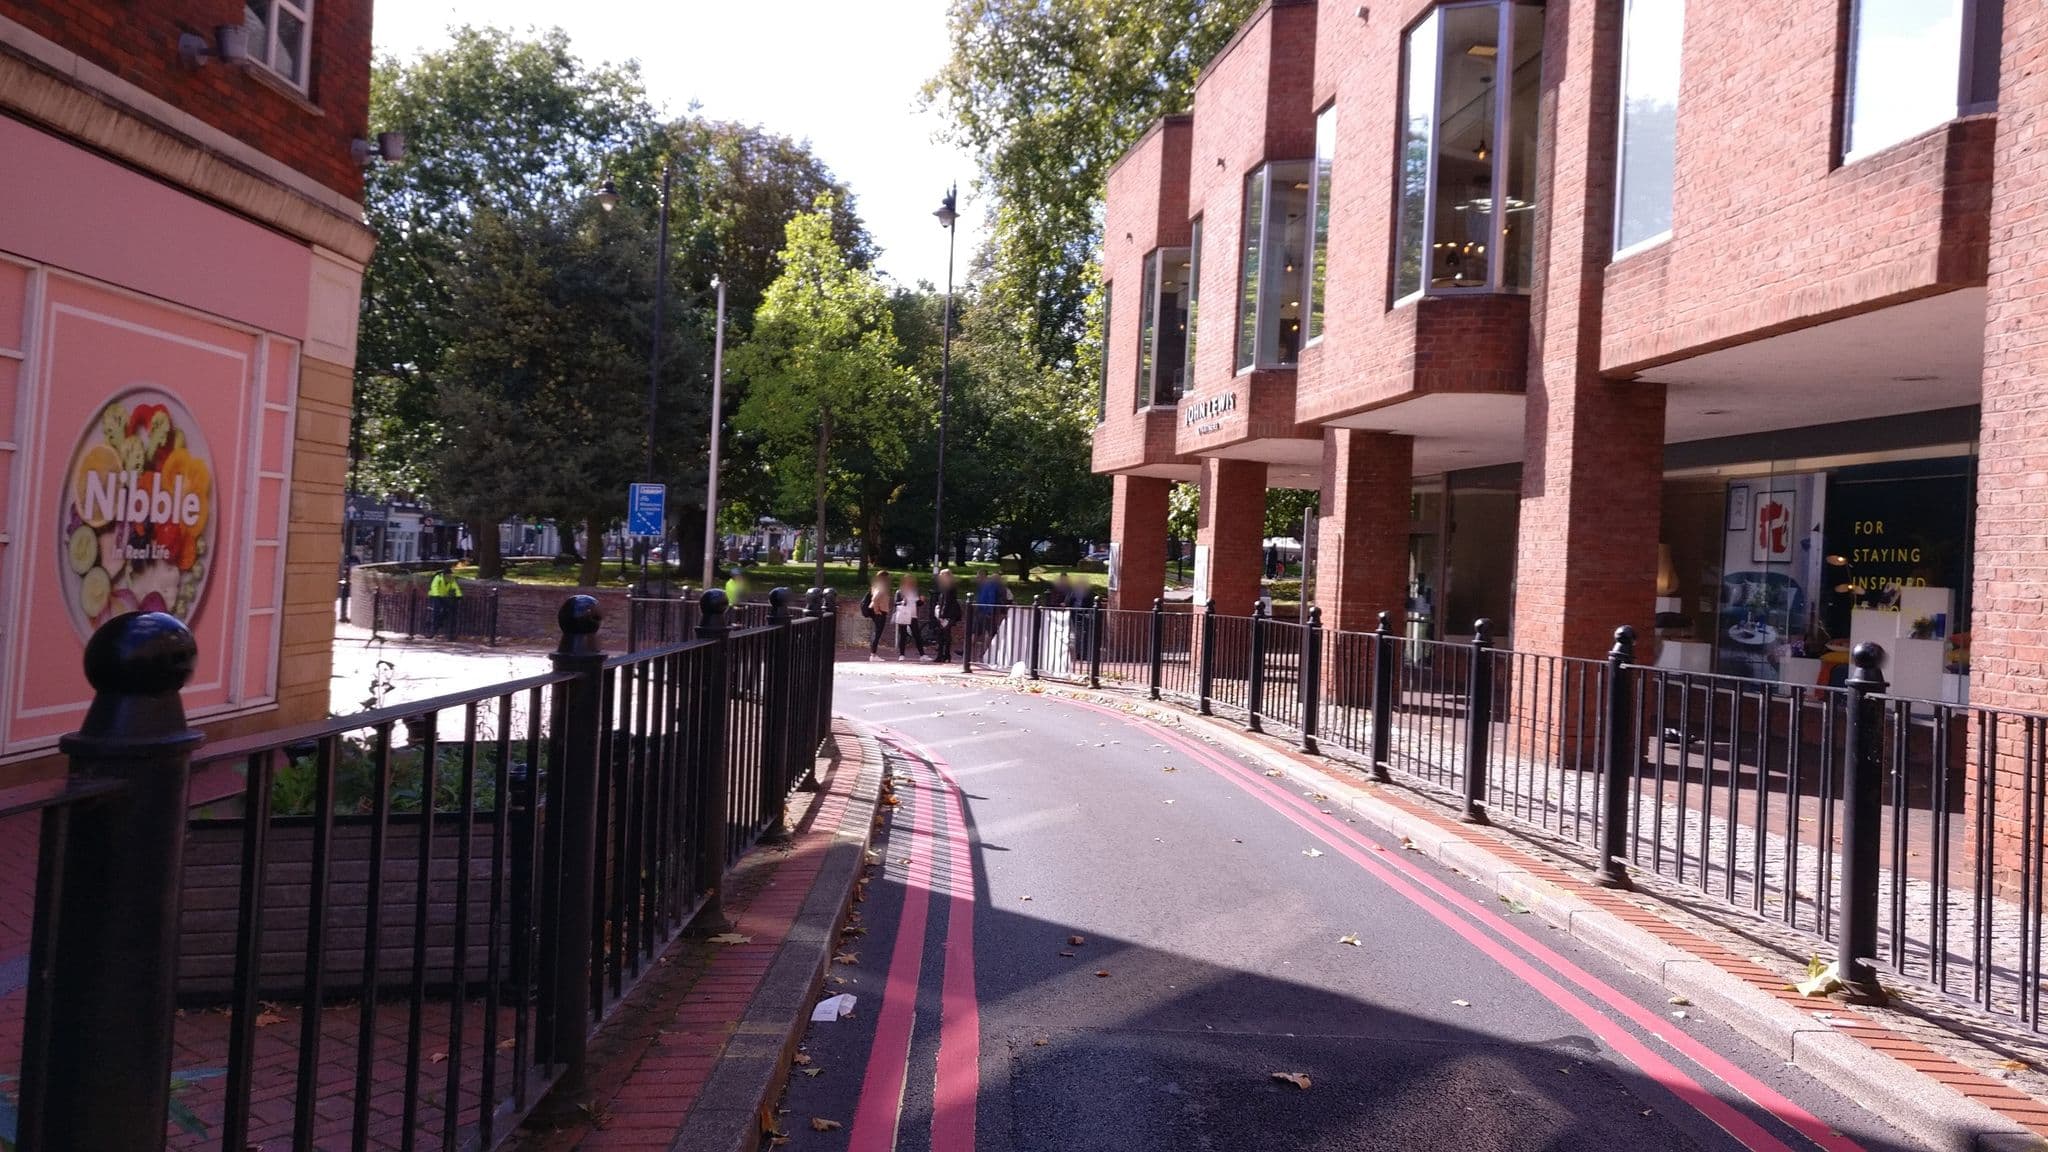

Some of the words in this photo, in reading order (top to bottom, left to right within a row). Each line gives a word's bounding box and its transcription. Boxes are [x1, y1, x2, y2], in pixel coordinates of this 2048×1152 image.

[1185, 401, 1208, 427] JOHN
[1208, 392, 1237, 417] LEWIS
[83, 469, 200, 527] Nibble
[1854, 520, 1885, 535] FOR
[126, 544, 149, 560] Real
[151, 544, 170, 560] Life
[1853, 548, 1921, 563] STAYING
